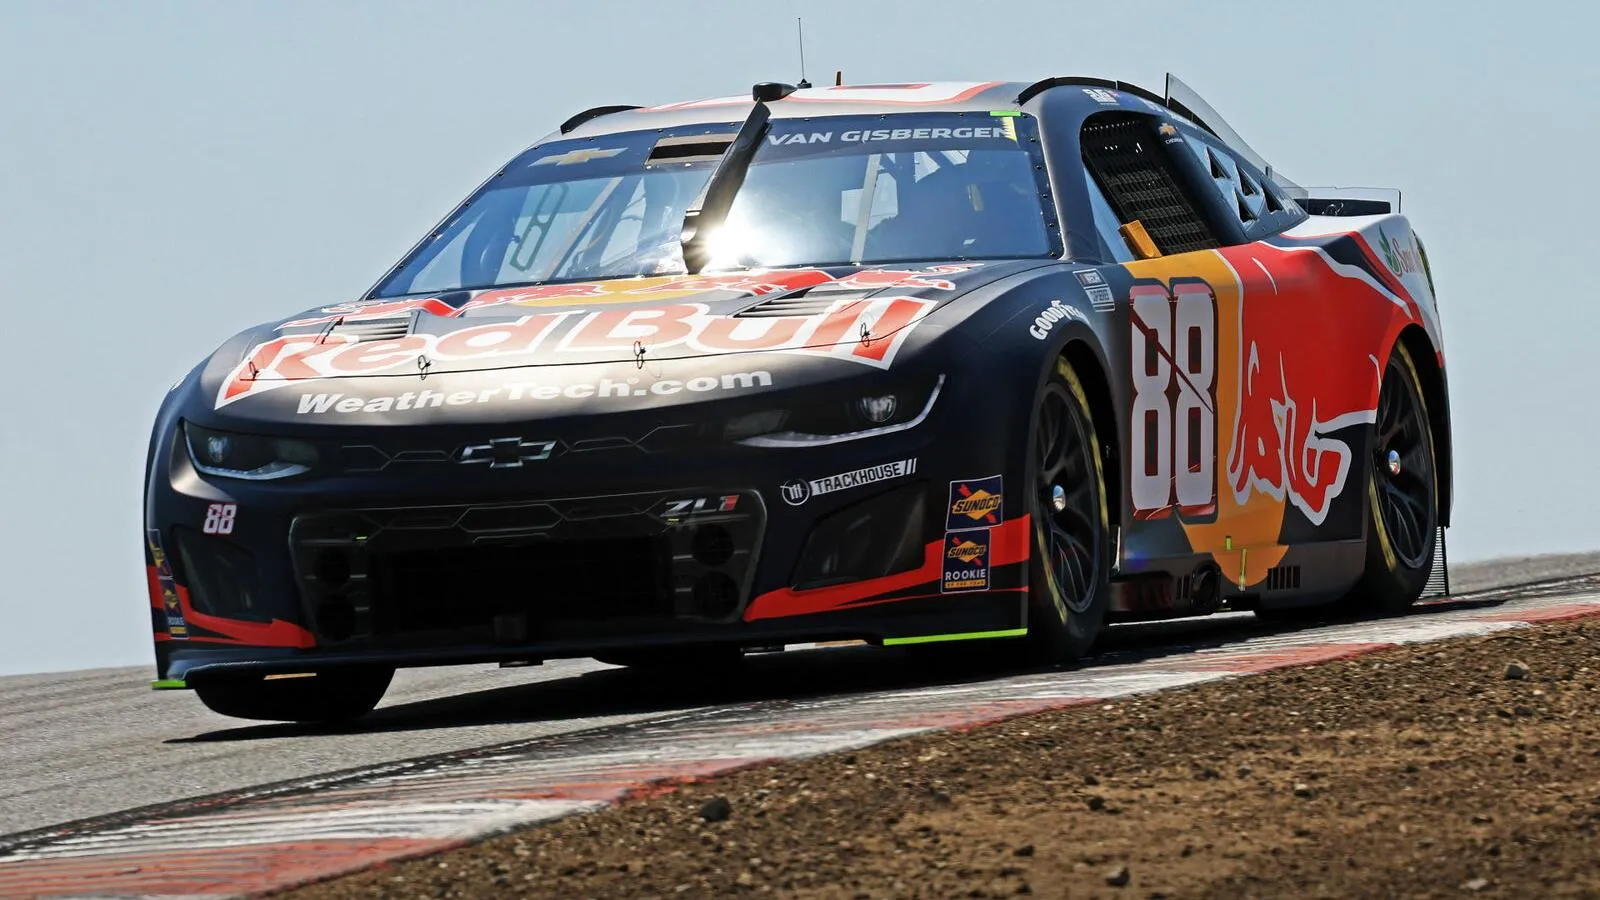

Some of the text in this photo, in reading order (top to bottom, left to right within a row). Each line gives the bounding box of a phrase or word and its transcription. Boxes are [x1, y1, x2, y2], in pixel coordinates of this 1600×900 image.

[766, 132, 833, 147] VAN
[215, 309, 587, 409] Red
[296, 369, 773, 415] WeatherTech.com
[1130, 284, 1216, 519] 88
[815, 462, 902, 494] TRACKHOUSE
[660, 495, 740, 517] ZL1
[954, 495, 1001, 513] SUNOCO
[203, 503, 236, 534] 88
[948, 545, 987, 558] SUNOCO
[944, 568, 987, 581] ROOKIE
